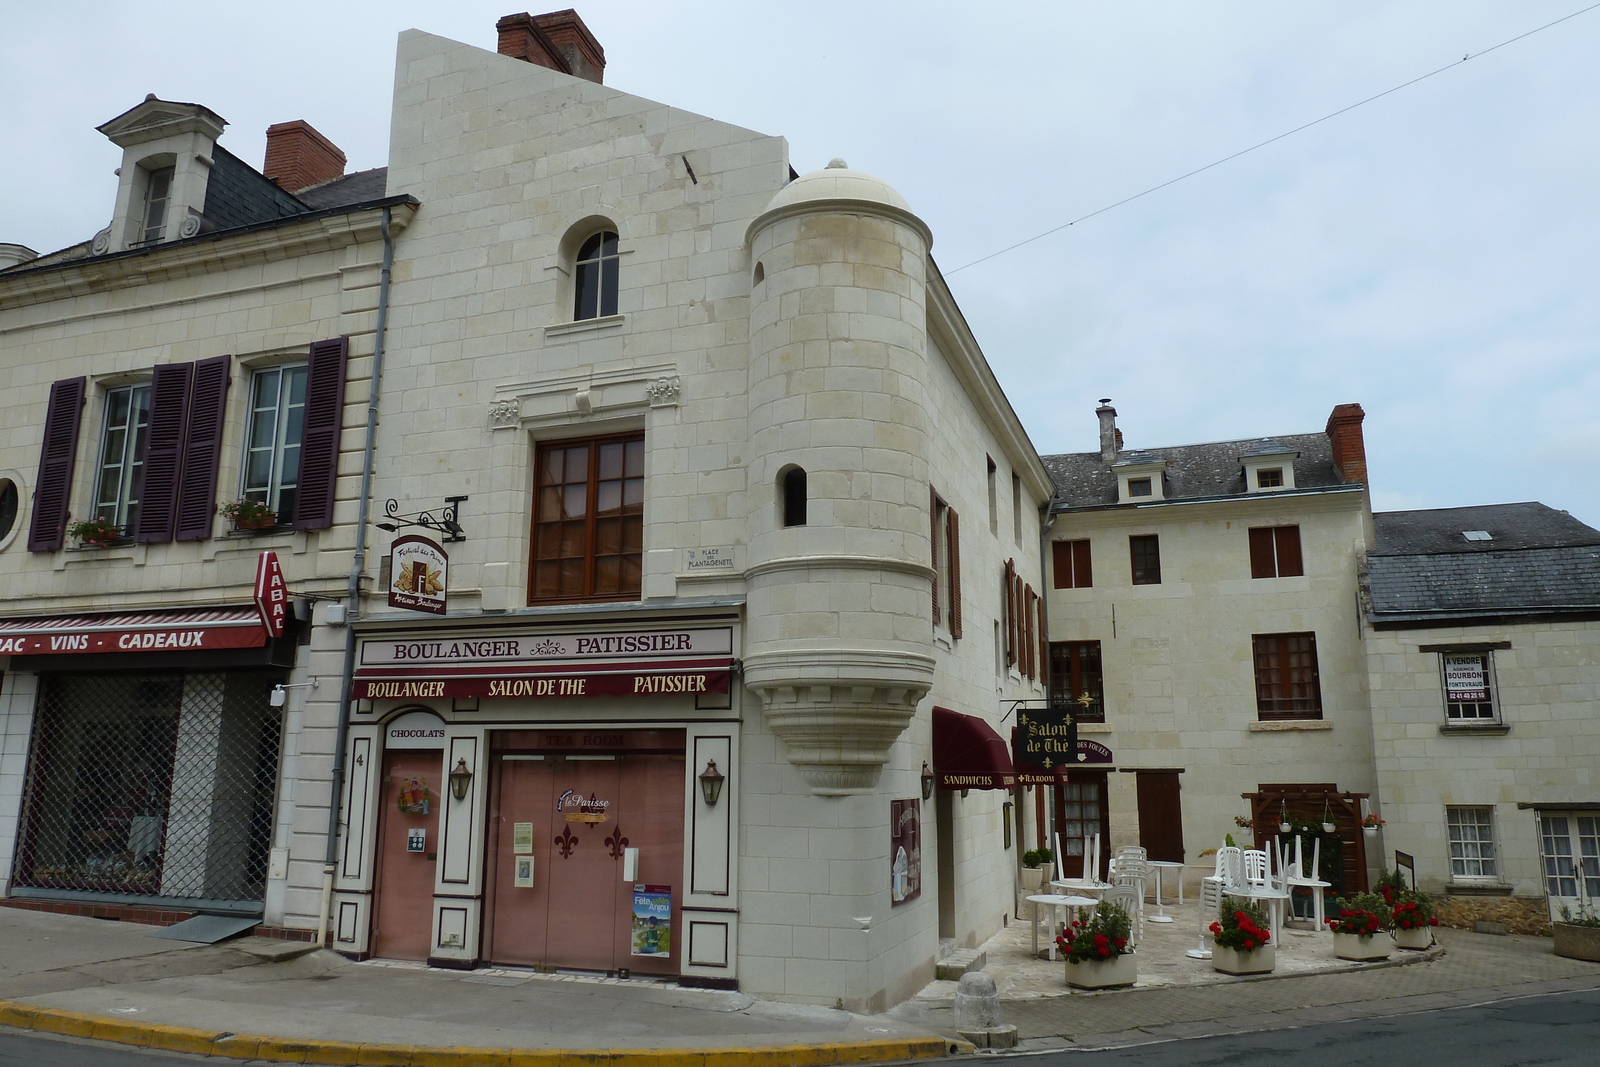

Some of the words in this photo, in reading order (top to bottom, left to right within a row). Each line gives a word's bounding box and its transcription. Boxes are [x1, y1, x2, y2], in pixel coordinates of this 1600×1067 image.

[270, 561, 284, 629] TABAC
[51, 634, 89, 650] VINS
[119, 631, 204, 649] CADEAUX
[393, 641, 520, 659] BOULANGER
[576, 633, 692, 654] PATISSIER
[1452, 657, 1480, 665] VENDRE
[367, 681, 445, 697] BOULANGER
[488, 680, 534, 696] SALON
[536, 680, 556, 696] DE
[559, 679, 586, 695] THE
[634, 675, 706, 692] PATISSIER
[391, 730, 445, 738] CHOCOLATS
[1028, 721, 1067, 738] Salon
[546, 735, 573, 745] TEA
[583, 735, 624, 745] ROOM
[1026, 739, 1040, 752] de
[1044, 738, 1069, 753] Thé
[356, 754, 363, 766] 4
[944, 775, 992, 785] SANDWICHS
[1024, 774, 1035, 782] TEA
[572, 794, 610, 807] Parisse
[649, 903, 669, 913] Anjou
